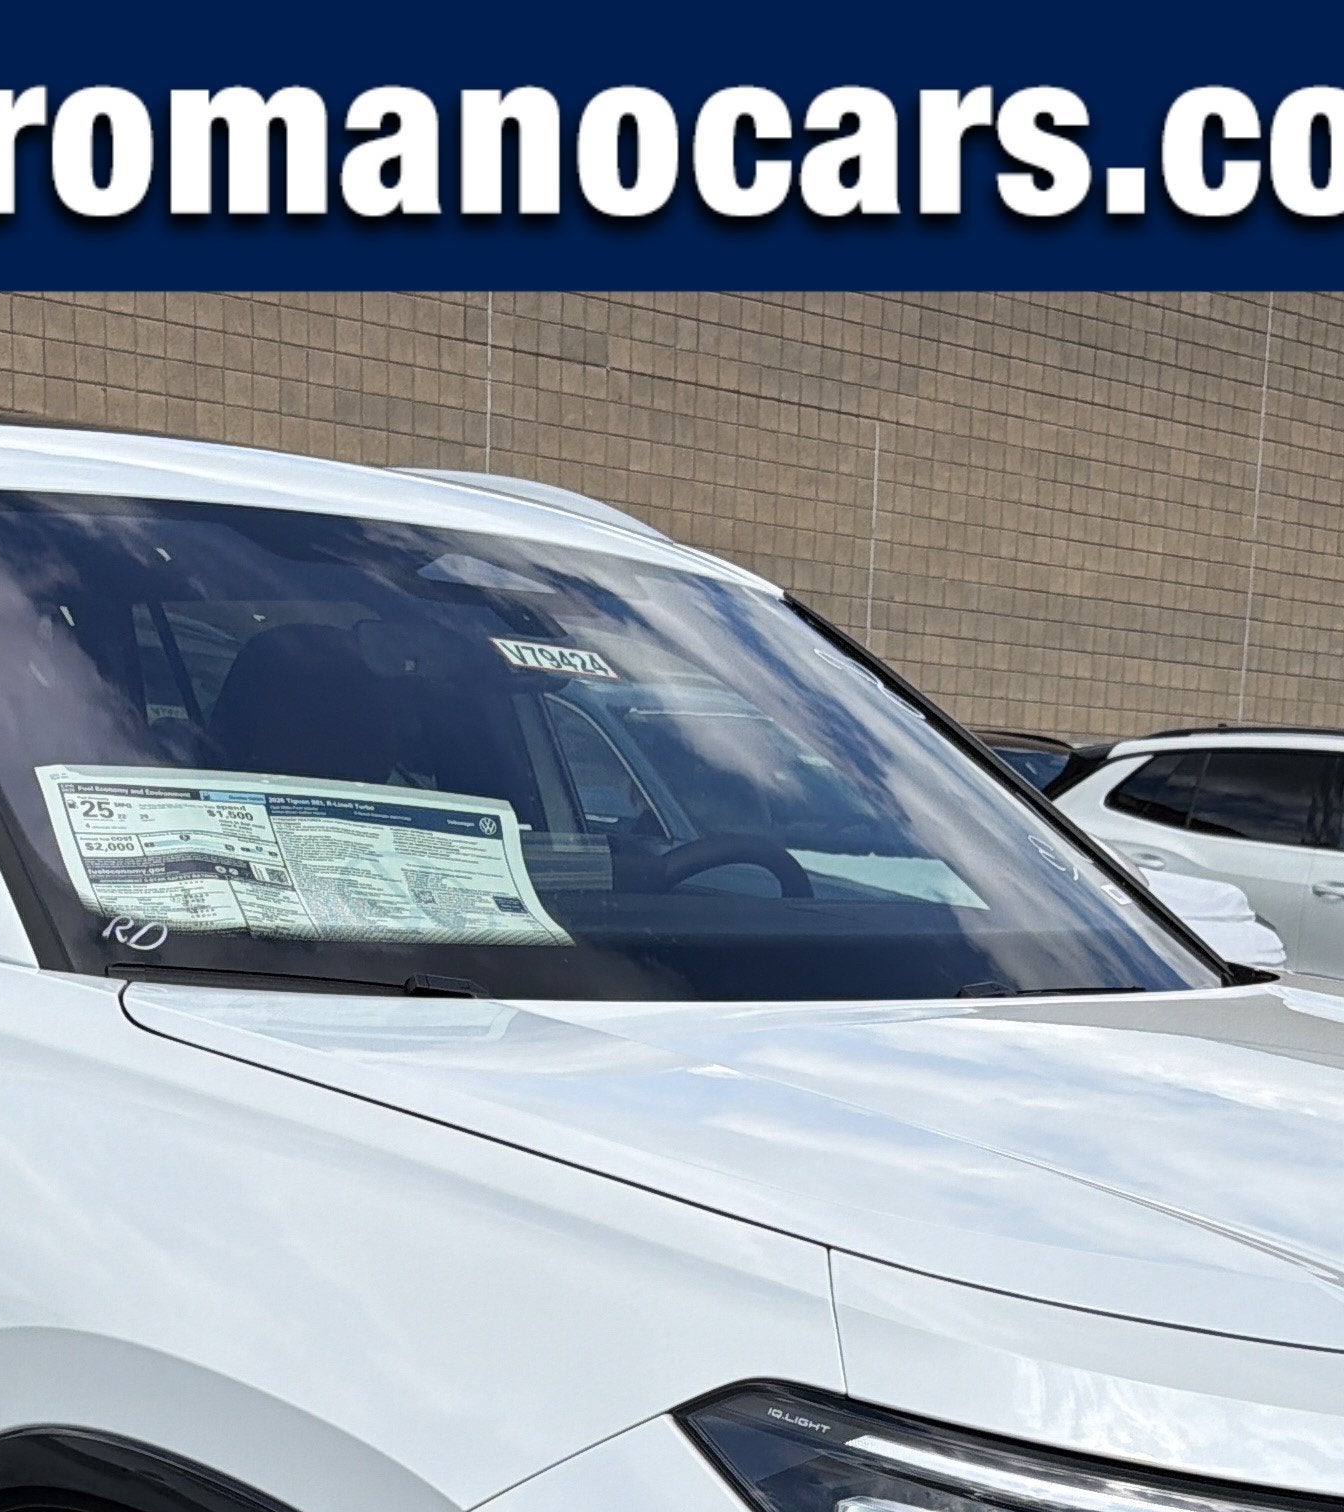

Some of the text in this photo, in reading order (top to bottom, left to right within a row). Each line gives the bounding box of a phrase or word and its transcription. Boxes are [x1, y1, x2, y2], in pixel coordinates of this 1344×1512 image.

[499, 641, 610, 677] V79424
[80, 800, 115, 819] 25
[207, 809, 254, 822] $1,500
[84, 842, 135, 853] $2,000
[767, 1406, 831, 1435] IQ.LIGHT
